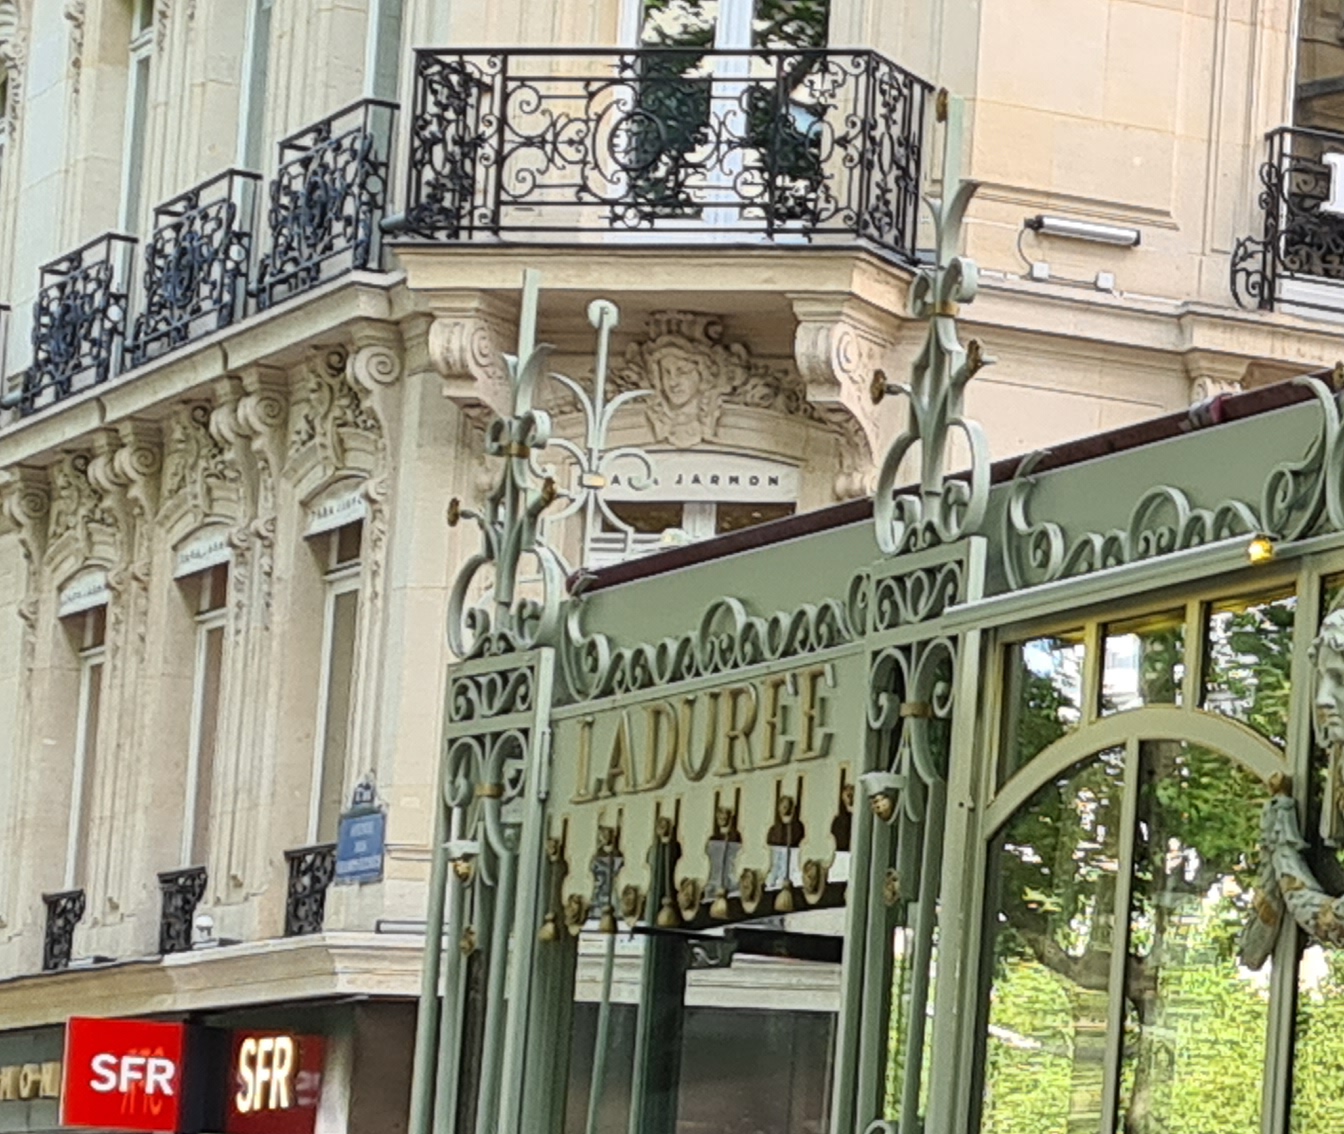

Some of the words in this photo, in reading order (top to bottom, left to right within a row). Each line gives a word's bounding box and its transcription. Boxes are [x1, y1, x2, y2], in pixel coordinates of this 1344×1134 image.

[675, 473, 779, 486] JARMON
[90, 1053, 176, 1096] SFR
[235, 1036, 294, 1114] SFR
